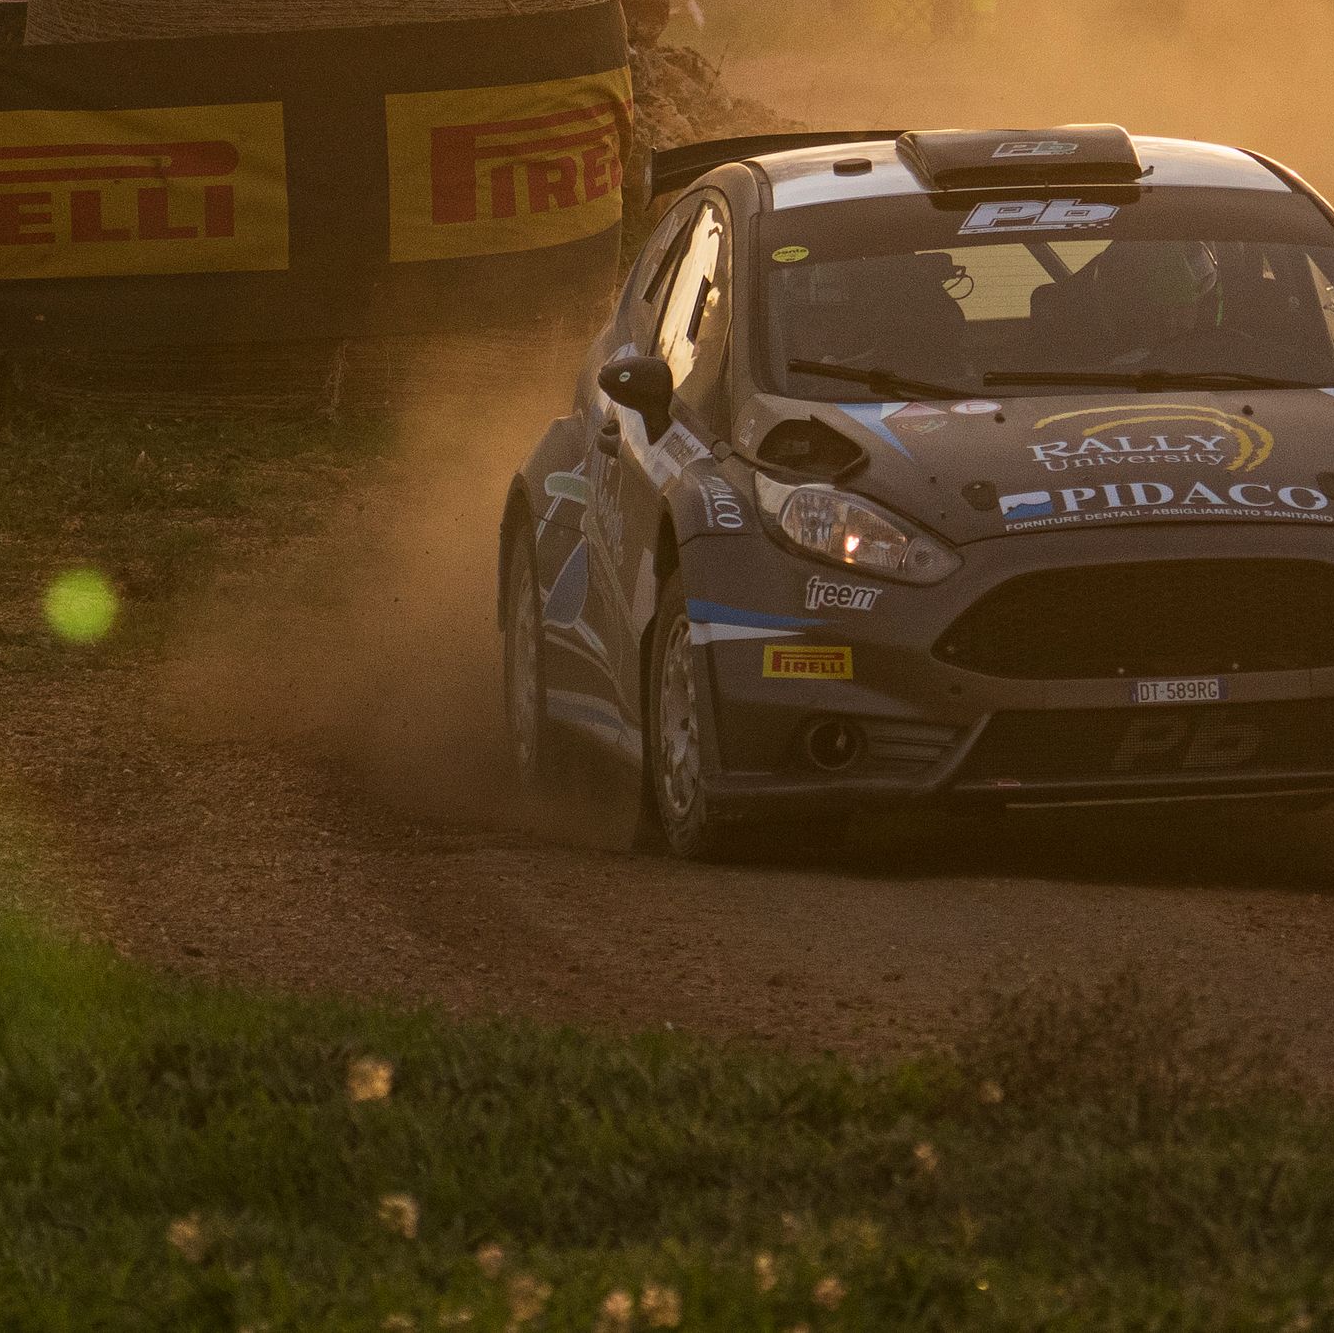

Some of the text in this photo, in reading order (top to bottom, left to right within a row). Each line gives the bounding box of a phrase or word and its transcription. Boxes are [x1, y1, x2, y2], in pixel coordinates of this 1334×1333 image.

[431, 99, 633, 224] PIRE
[959, 198, 1121, 233] Pb
[1026, 434, 1227, 462] RALLY
[1044, 451, 1227, 472] University
[1055, 480, 1330, 514] PIDACO
[1005, 514, 1082, 532] FORNITURE
[1084, 509, 1142, 521] DENTALI
[1151, 507, 1261, 517] ABBIGLIAMENTO
[1263, 509, 1334, 523] SANITARIO
[805, 575, 878, 611] freem
[771, 650, 845, 674] PIRELLI
